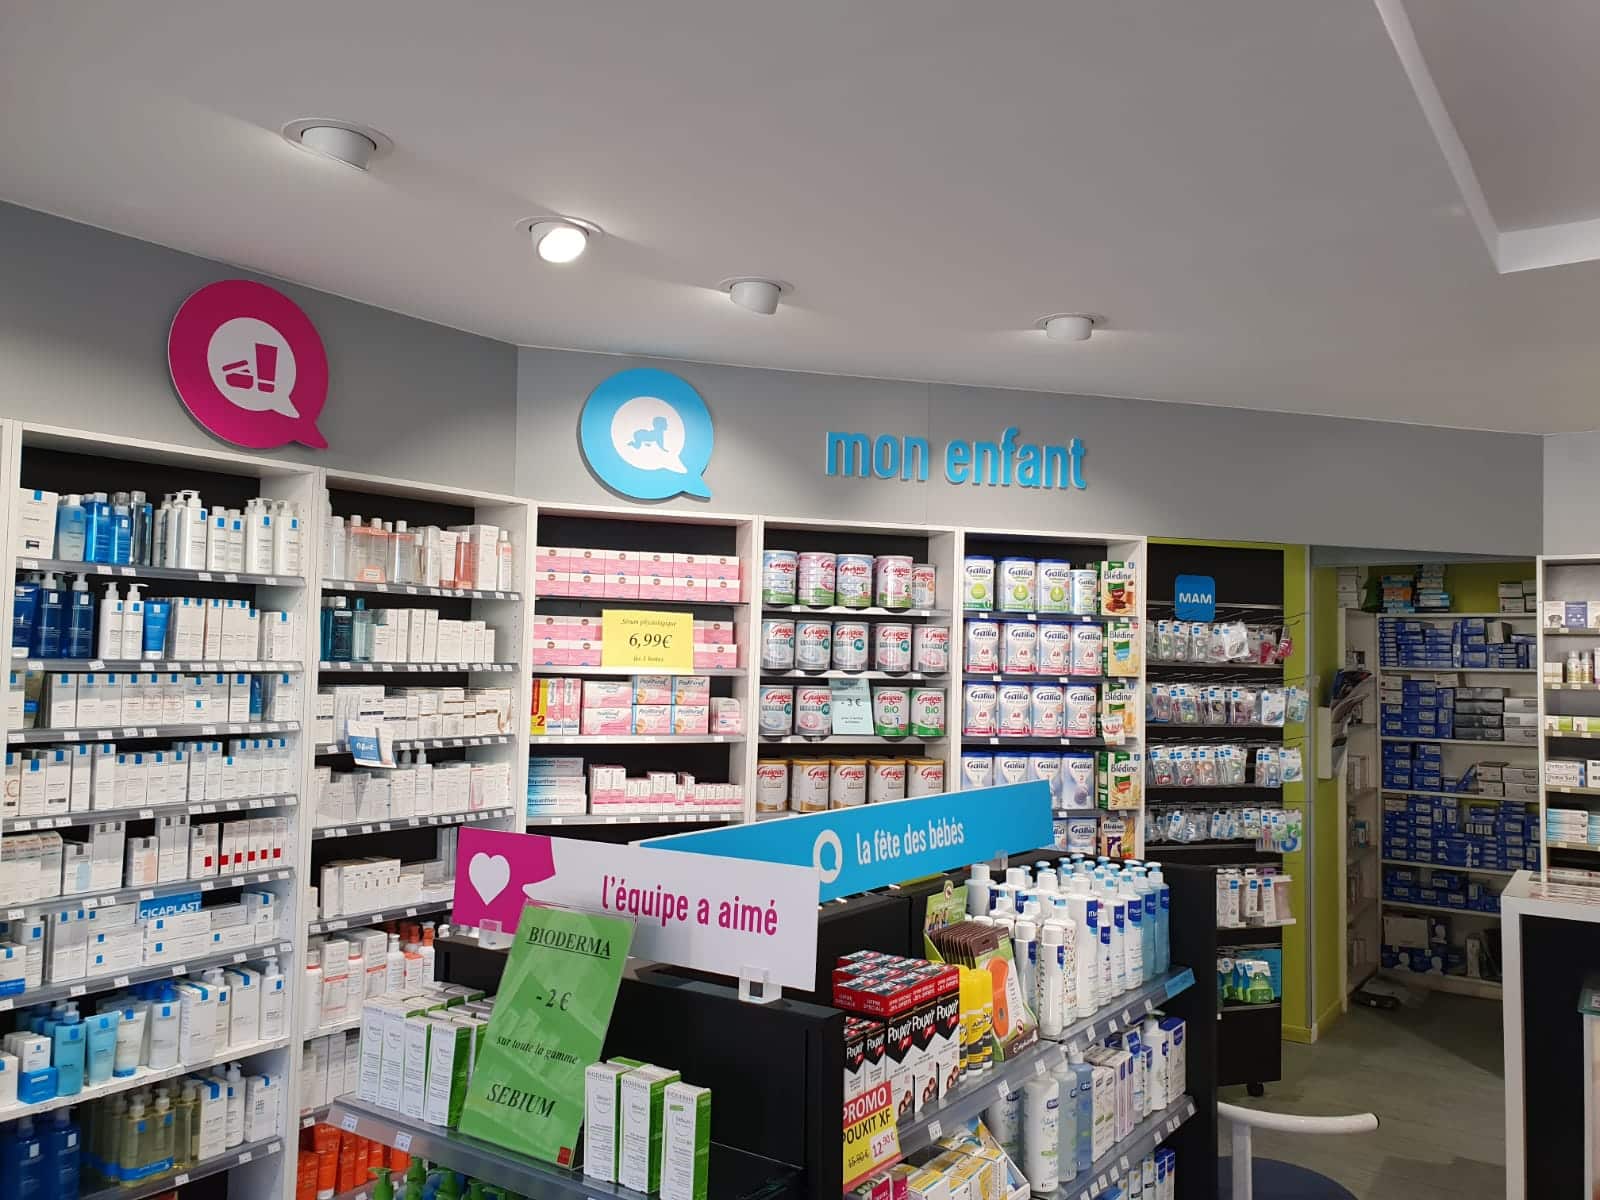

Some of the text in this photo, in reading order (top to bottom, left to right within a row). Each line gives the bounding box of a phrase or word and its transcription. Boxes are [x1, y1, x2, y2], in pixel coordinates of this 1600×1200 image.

[825, 426, 1088, 490] mon enfant
[1179, 592, 1212, 605] MAM
[629, 633, 673, 648] 6,99€
[884, 706, 898, 714] BIO
[925, 706, 939, 714] BIO
[856, 815, 965, 865] la fête des bébés
[140, 902, 201, 919] CICAPLAST
[602, 874, 778, 936] l'équipe a aimé
[528, 926, 612, 957] BIODERMA
[545, 988, 557, 1009] 2
[560, 991, 572, 1011] €
[496, 1035, 578, 1065] sur toute la gamme
[486, 1083, 556, 1119] SEBIUM
[843, 1086, 888, 1124] PROMO
[879, 1108, 891, 1127] XF
